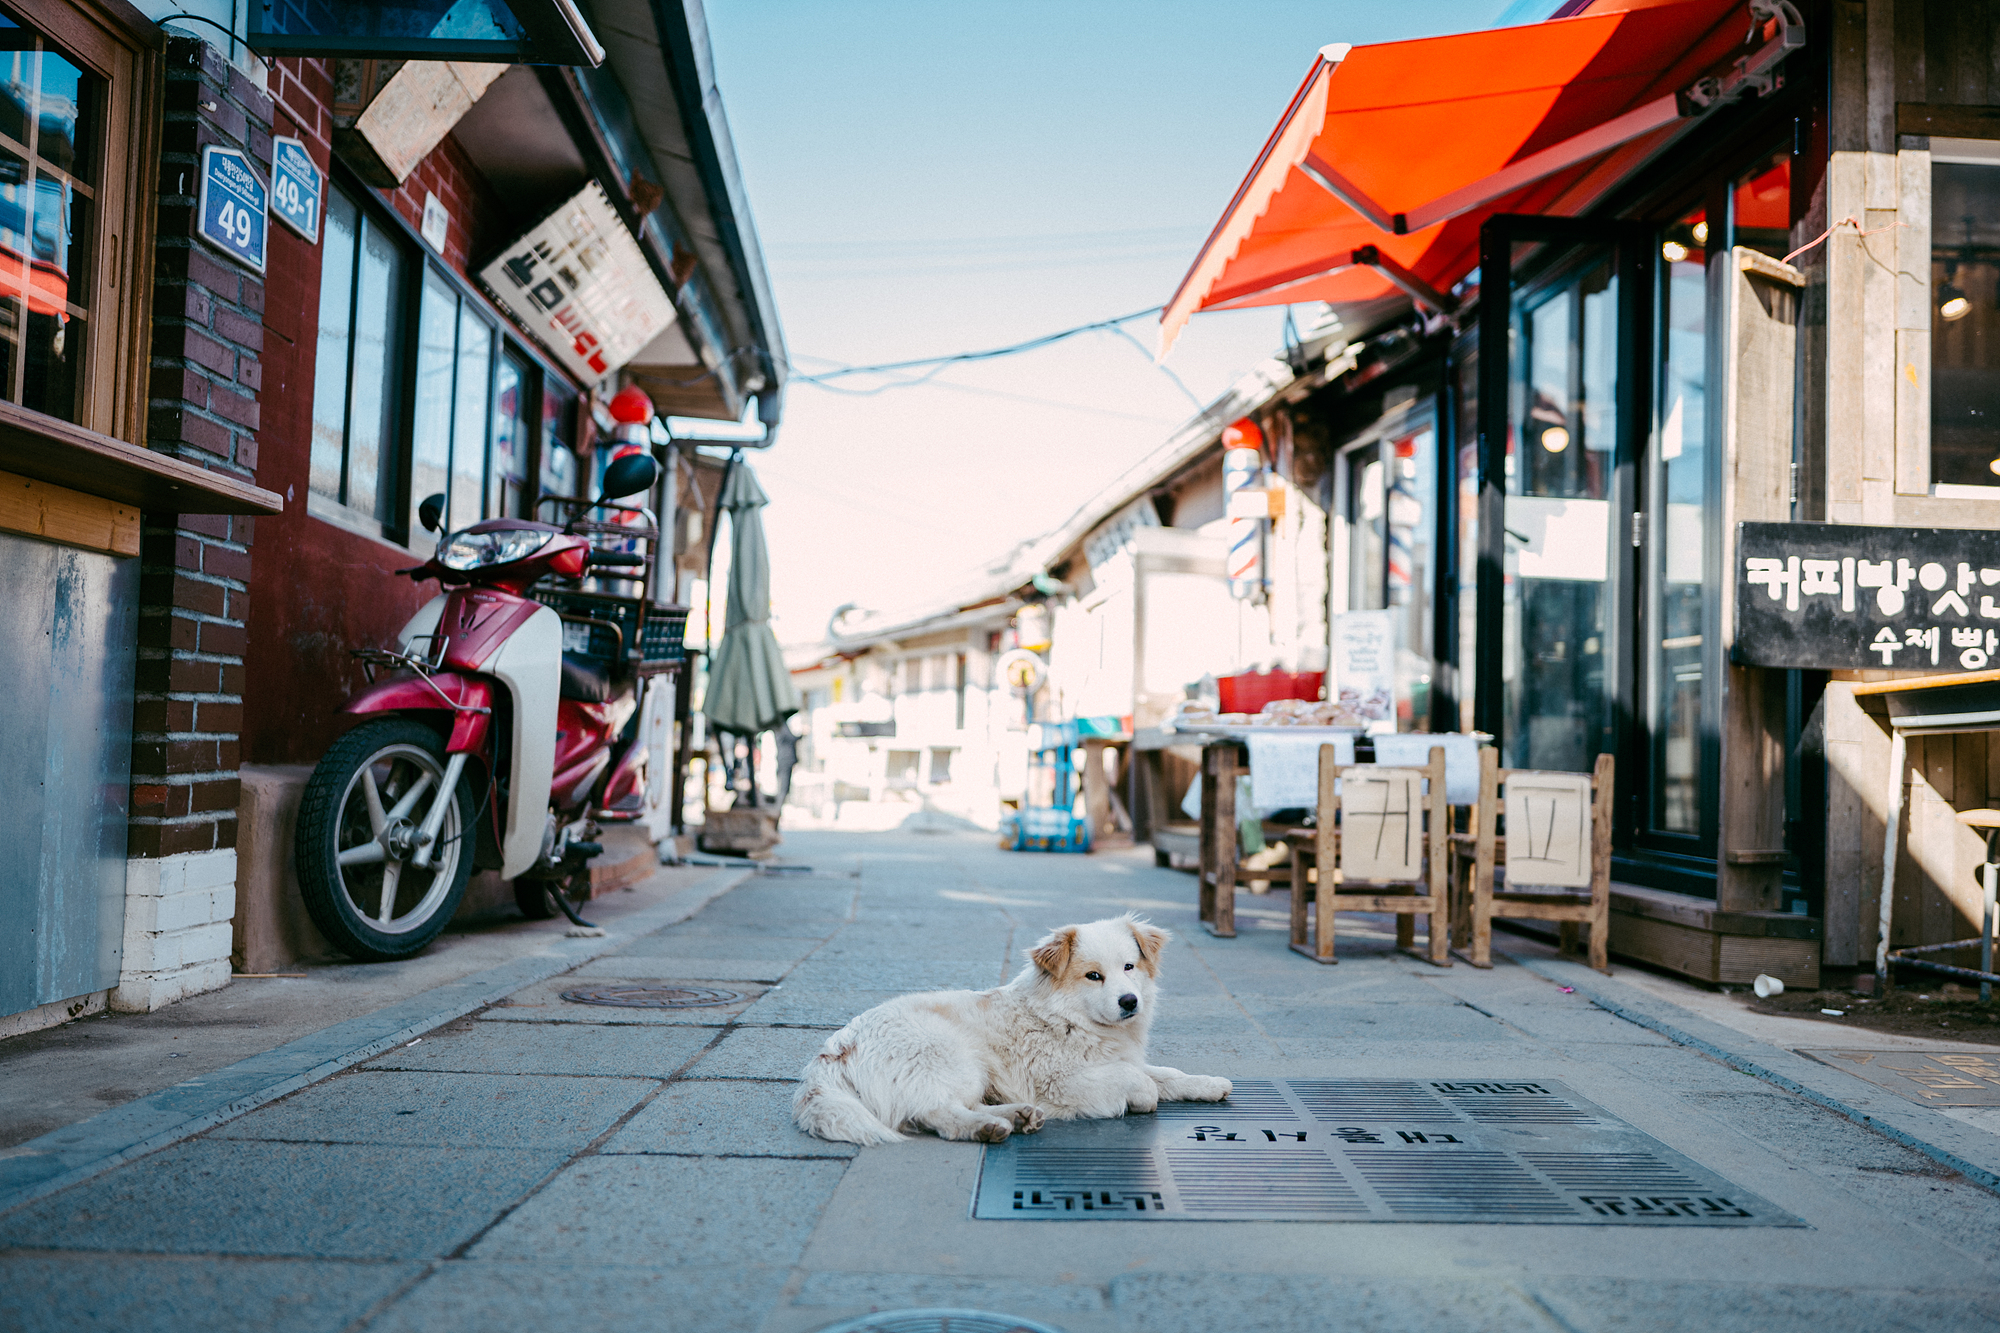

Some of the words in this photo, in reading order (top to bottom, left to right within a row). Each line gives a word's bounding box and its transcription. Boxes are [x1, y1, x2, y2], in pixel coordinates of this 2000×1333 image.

[218, 200, 251, 248] 49
[276, 174, 314, 228] 49-1
[1869, 626, 1941, 666] 수제
[1951, 626, 2000, 670] 빵
[1510, 783, 1583, 877] 피
